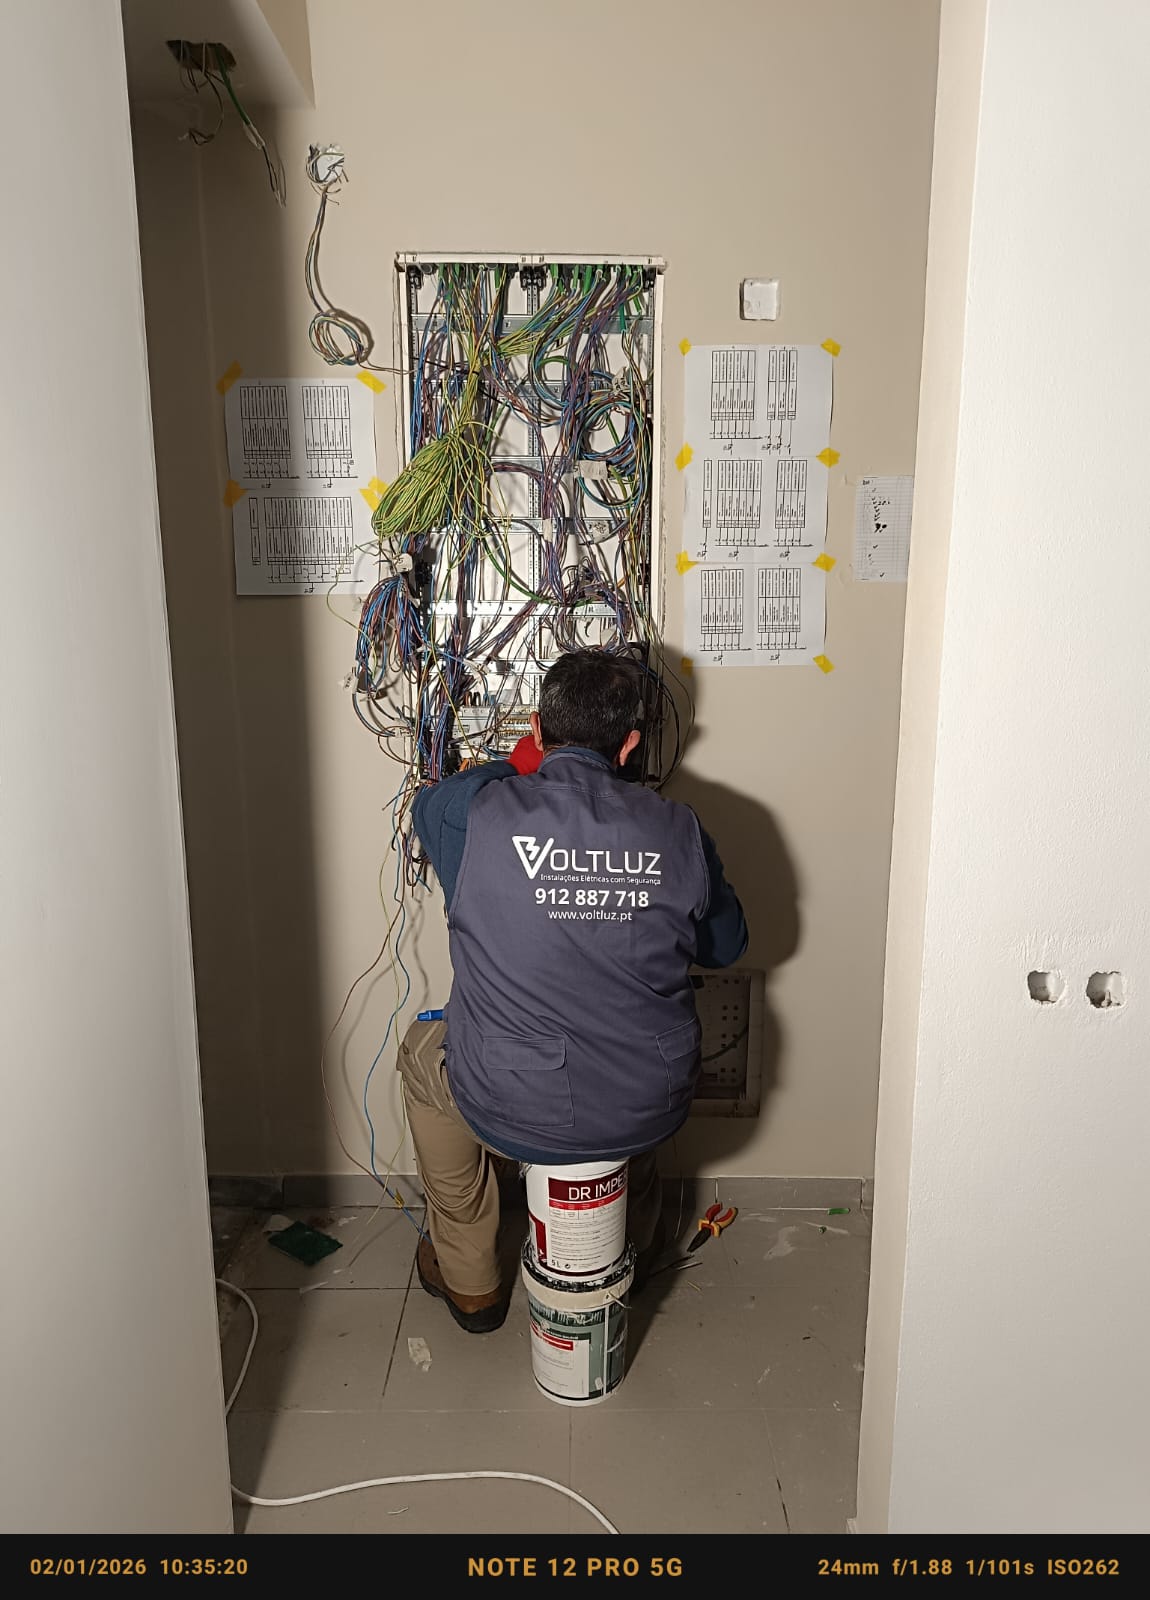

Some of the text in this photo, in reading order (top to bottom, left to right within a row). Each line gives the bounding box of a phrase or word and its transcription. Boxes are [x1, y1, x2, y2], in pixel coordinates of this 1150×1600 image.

[512, 835, 662, 879] VOLTLUZ
[540, 873, 580, 883] Instalações
[581, 875, 609, 883] Elétricas
[626, 876, 661, 886] Segurança
[535, 888, 649, 907] 912 887 718
[548, 909, 632, 922] www.voltluz.pt
[568, 1186, 591, 1200] DR
